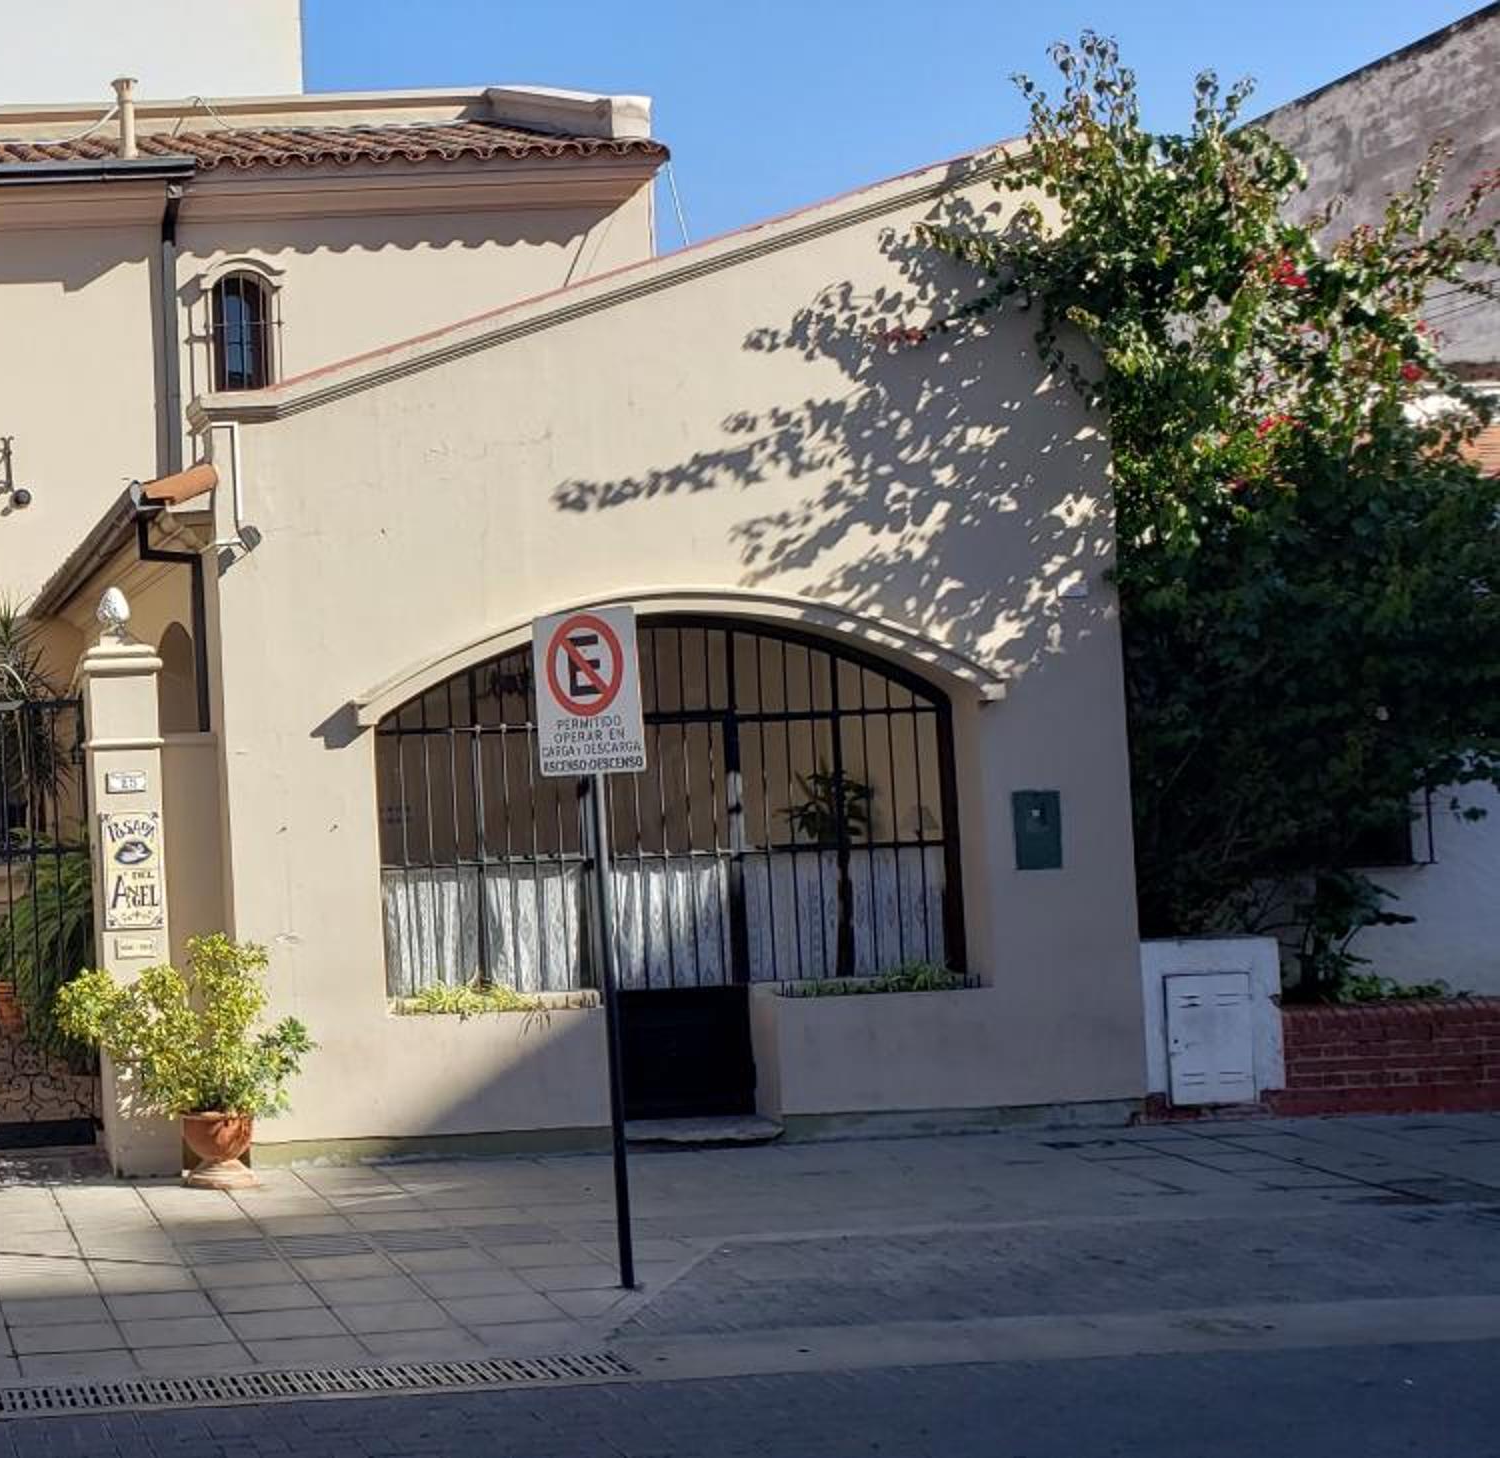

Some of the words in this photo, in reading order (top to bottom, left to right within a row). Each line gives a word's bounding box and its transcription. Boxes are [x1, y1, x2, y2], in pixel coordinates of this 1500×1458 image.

[568, 634, 603, 696] E
[557, 715, 621, 730] PERMITIDO
[554, 729, 603, 743] OPERAR
[609, 727, 625, 740] EN
[542, 744, 575, 757] CARGA
[584, 741, 642, 755] DESCARGA
